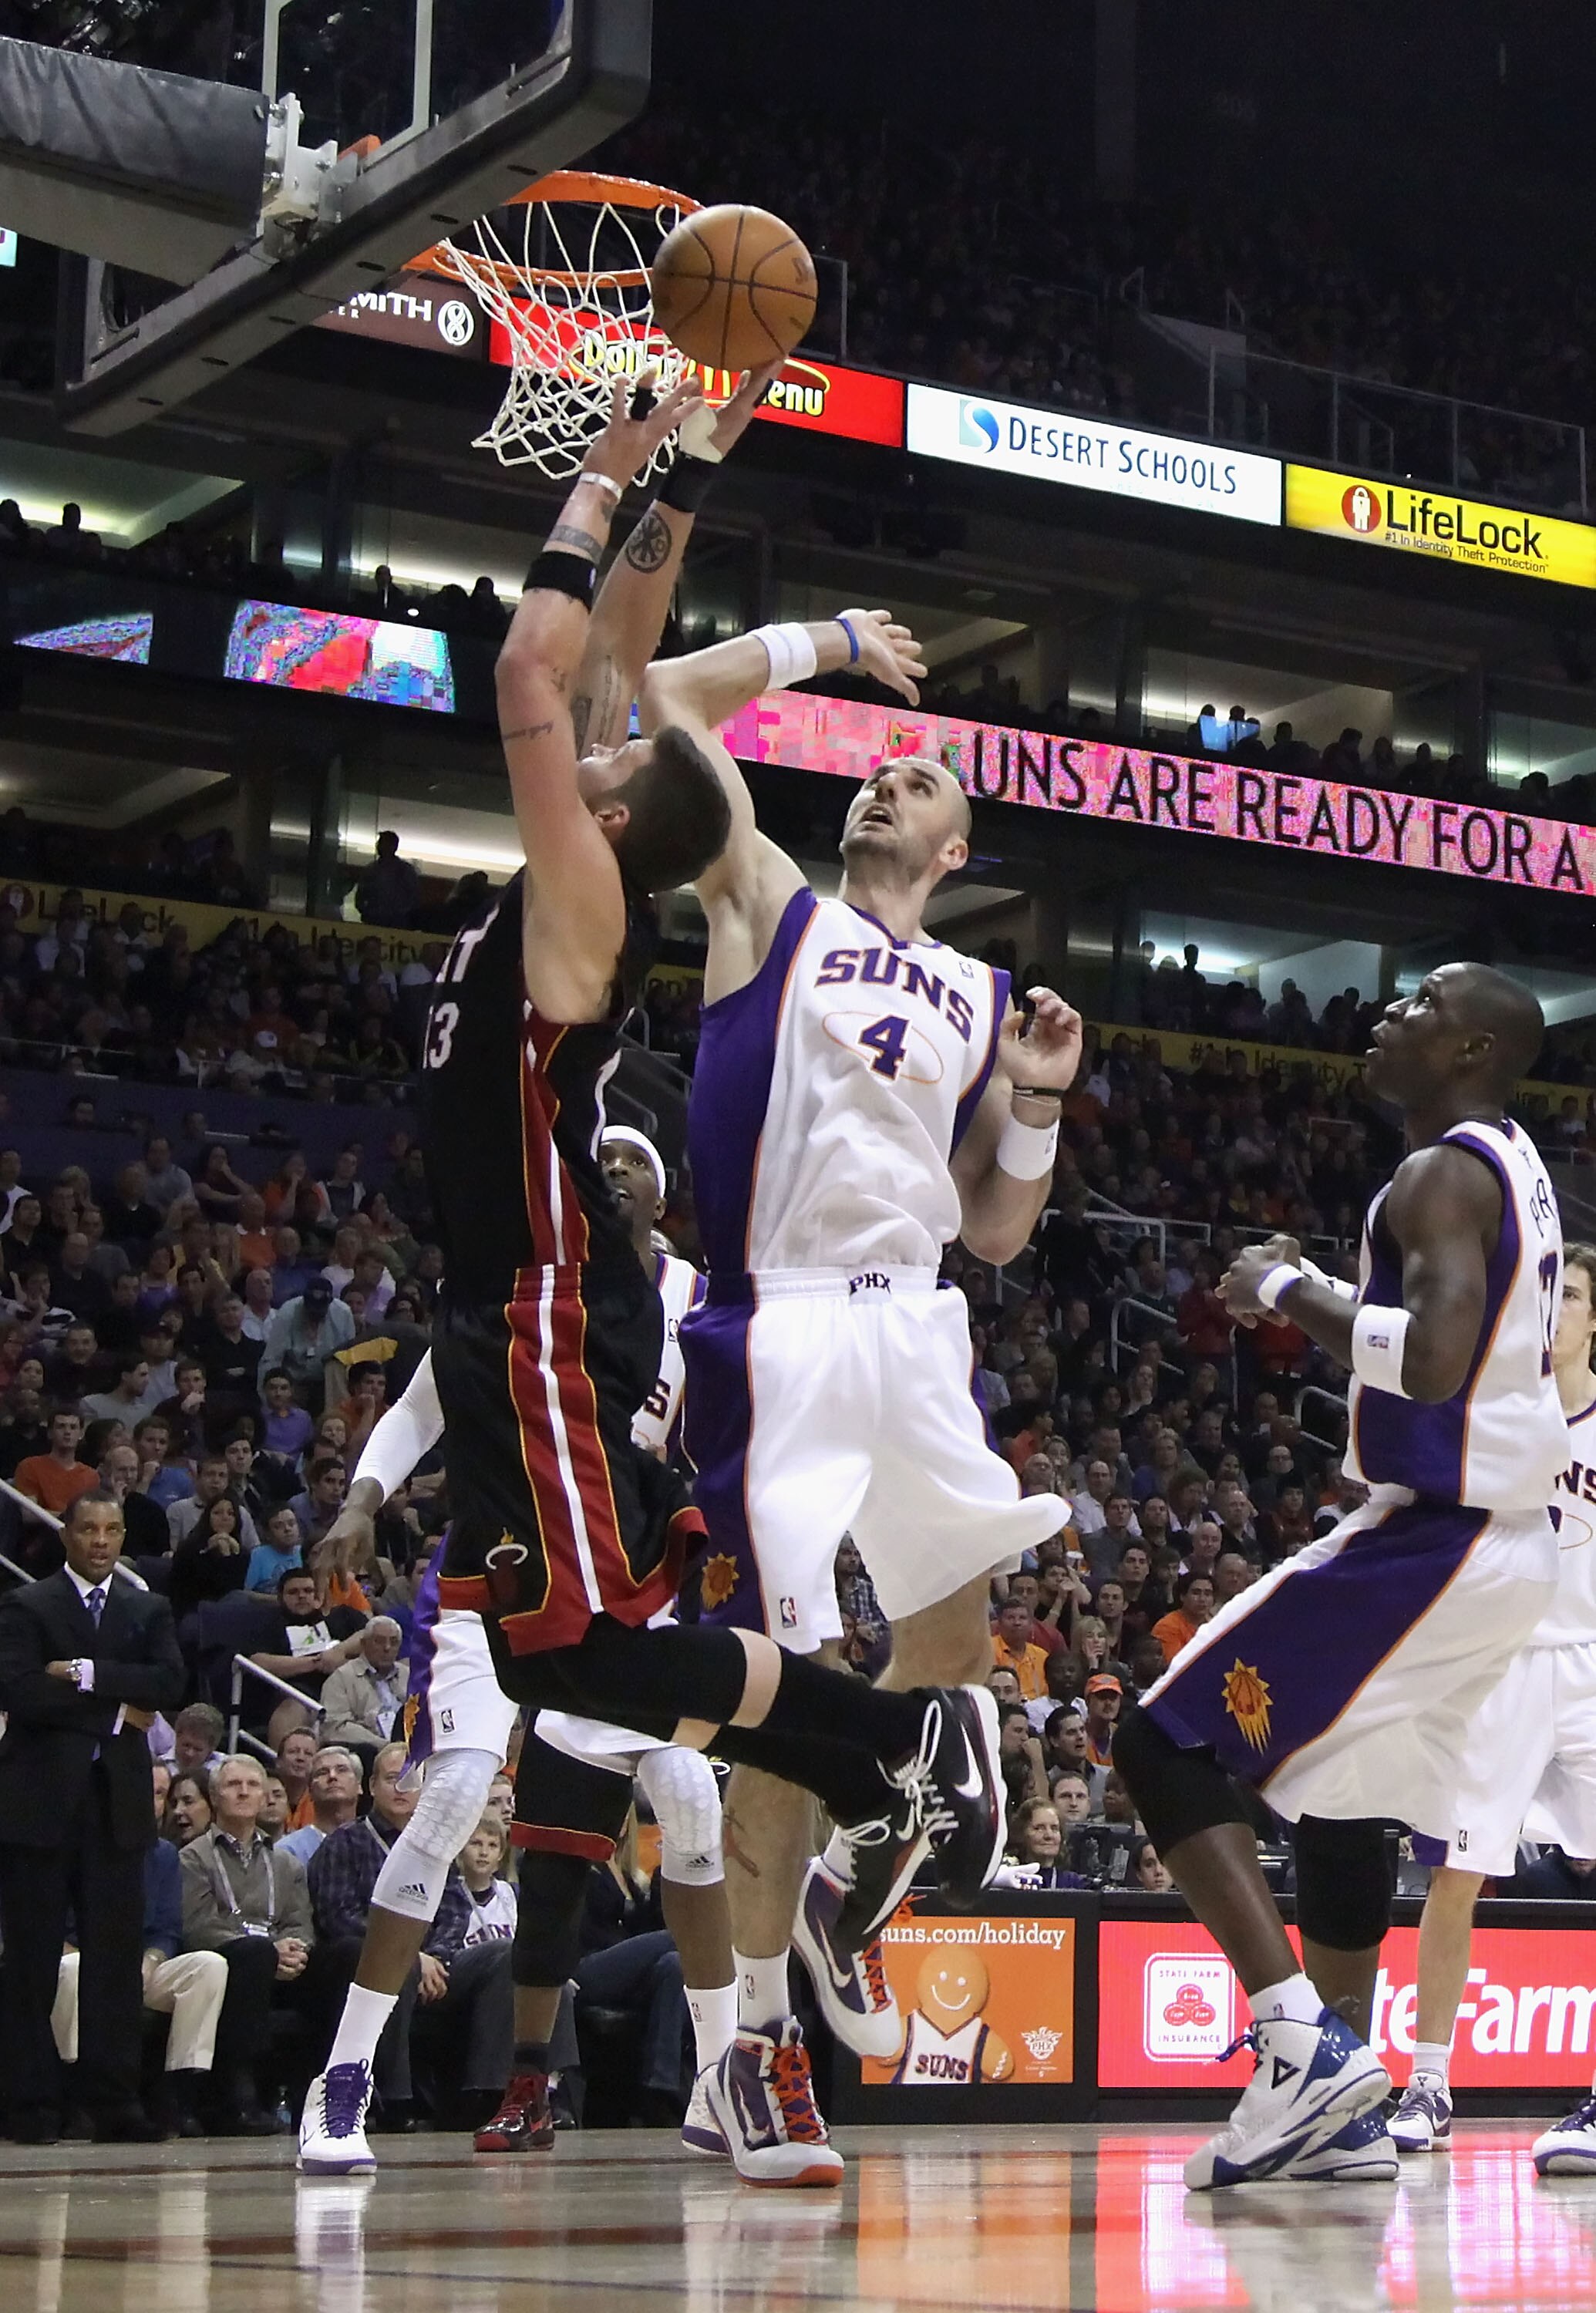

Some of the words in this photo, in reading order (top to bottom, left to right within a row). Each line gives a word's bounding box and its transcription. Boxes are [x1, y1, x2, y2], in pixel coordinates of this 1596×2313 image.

[329, 306, 359, 318] ER
[763, 380, 823, 416] enu
[1386, 490, 1544, 559] LifeLock
[1385, 532, 1397, 544] #1
[1413, 536, 1453, 557] Identity
[1456, 545, 1485, 561] Theft
[1106, 752, 1216, 831] ARE
[1237, 772, 1412, 861] READY
[1433, 803, 1534, 883] FOR
[1551, 827, 1584, 891] A
[814, 948, 975, 1045] SUNS
[857, 1014, 911, 1081] 4
[850, 1273, 891, 1296] PHX
[914, 2052, 969, 2080] SUNS
